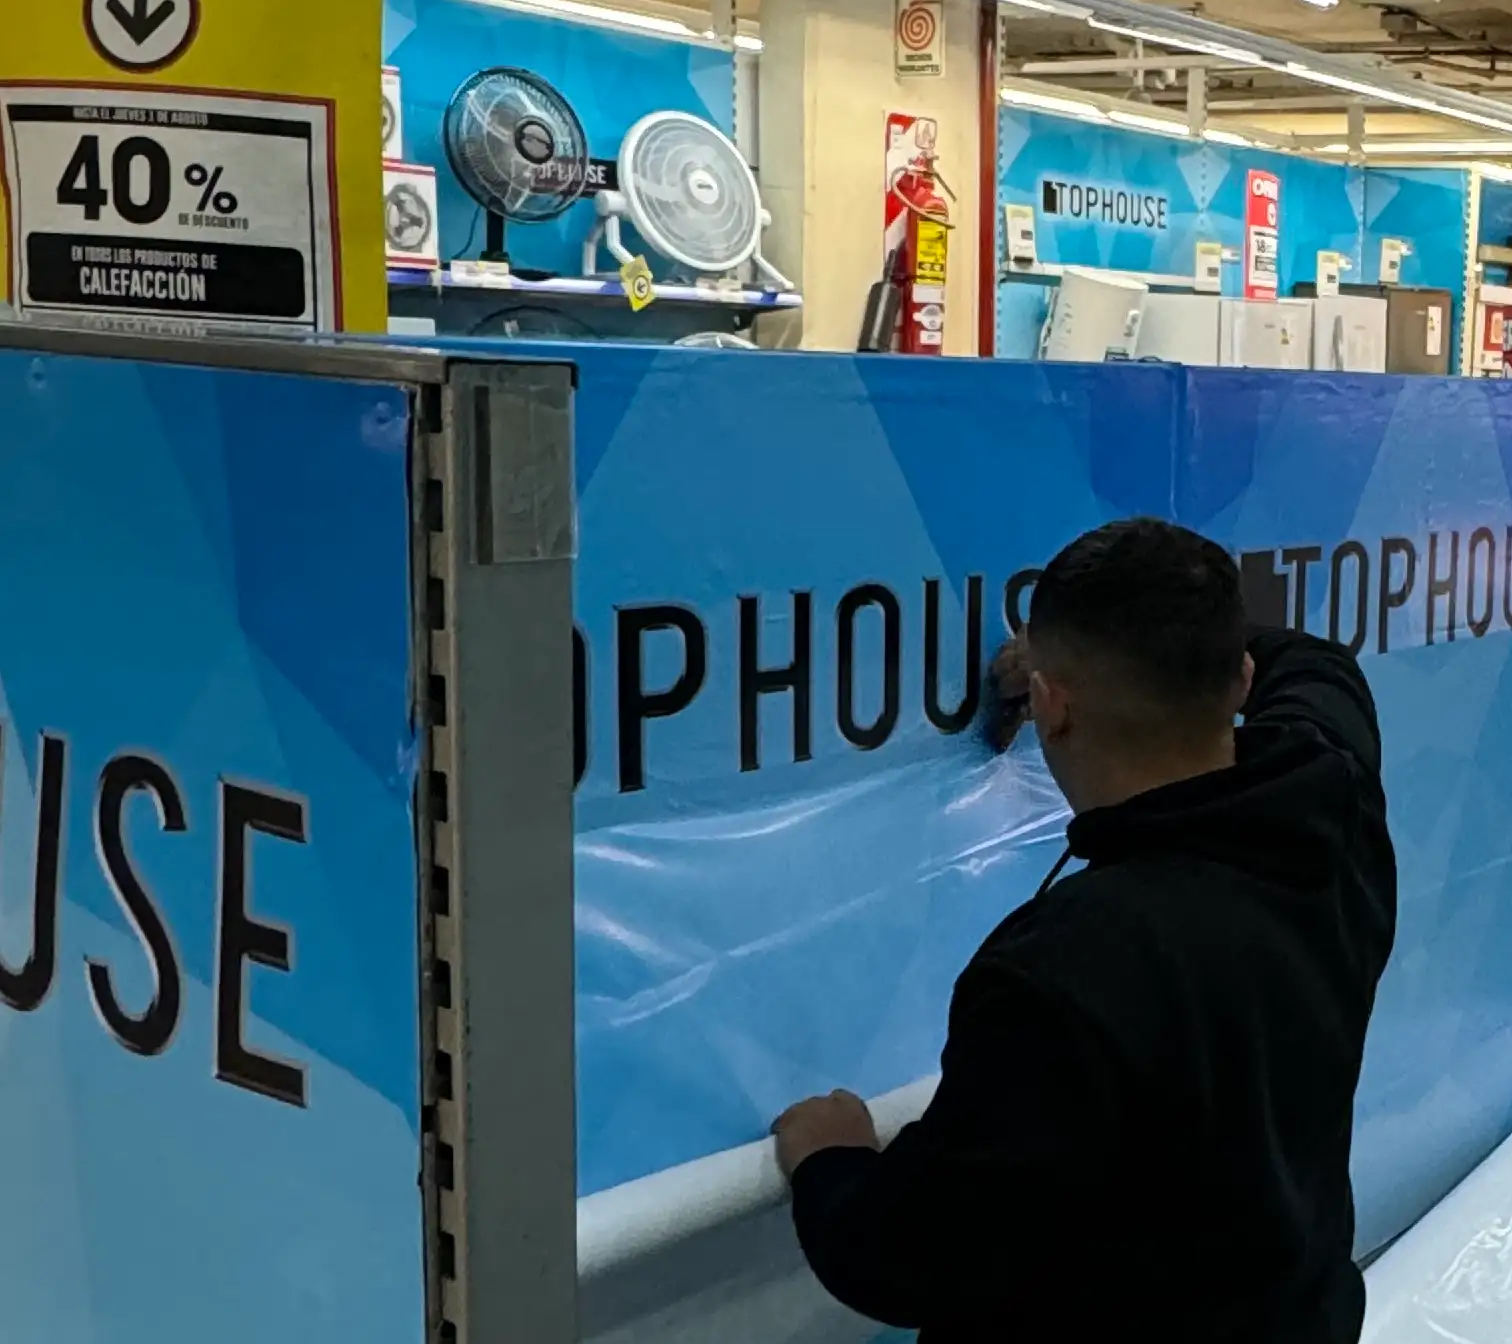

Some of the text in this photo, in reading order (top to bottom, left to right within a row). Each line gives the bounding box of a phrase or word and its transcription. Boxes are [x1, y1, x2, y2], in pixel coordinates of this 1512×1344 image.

[1054, 181, 1168, 230] TOPHOUSE
[134, 249, 199, 270] PRODUCTOS
[201, 254, 218, 270] DE
[79, 265, 207, 302] CALEFACCIÓN
